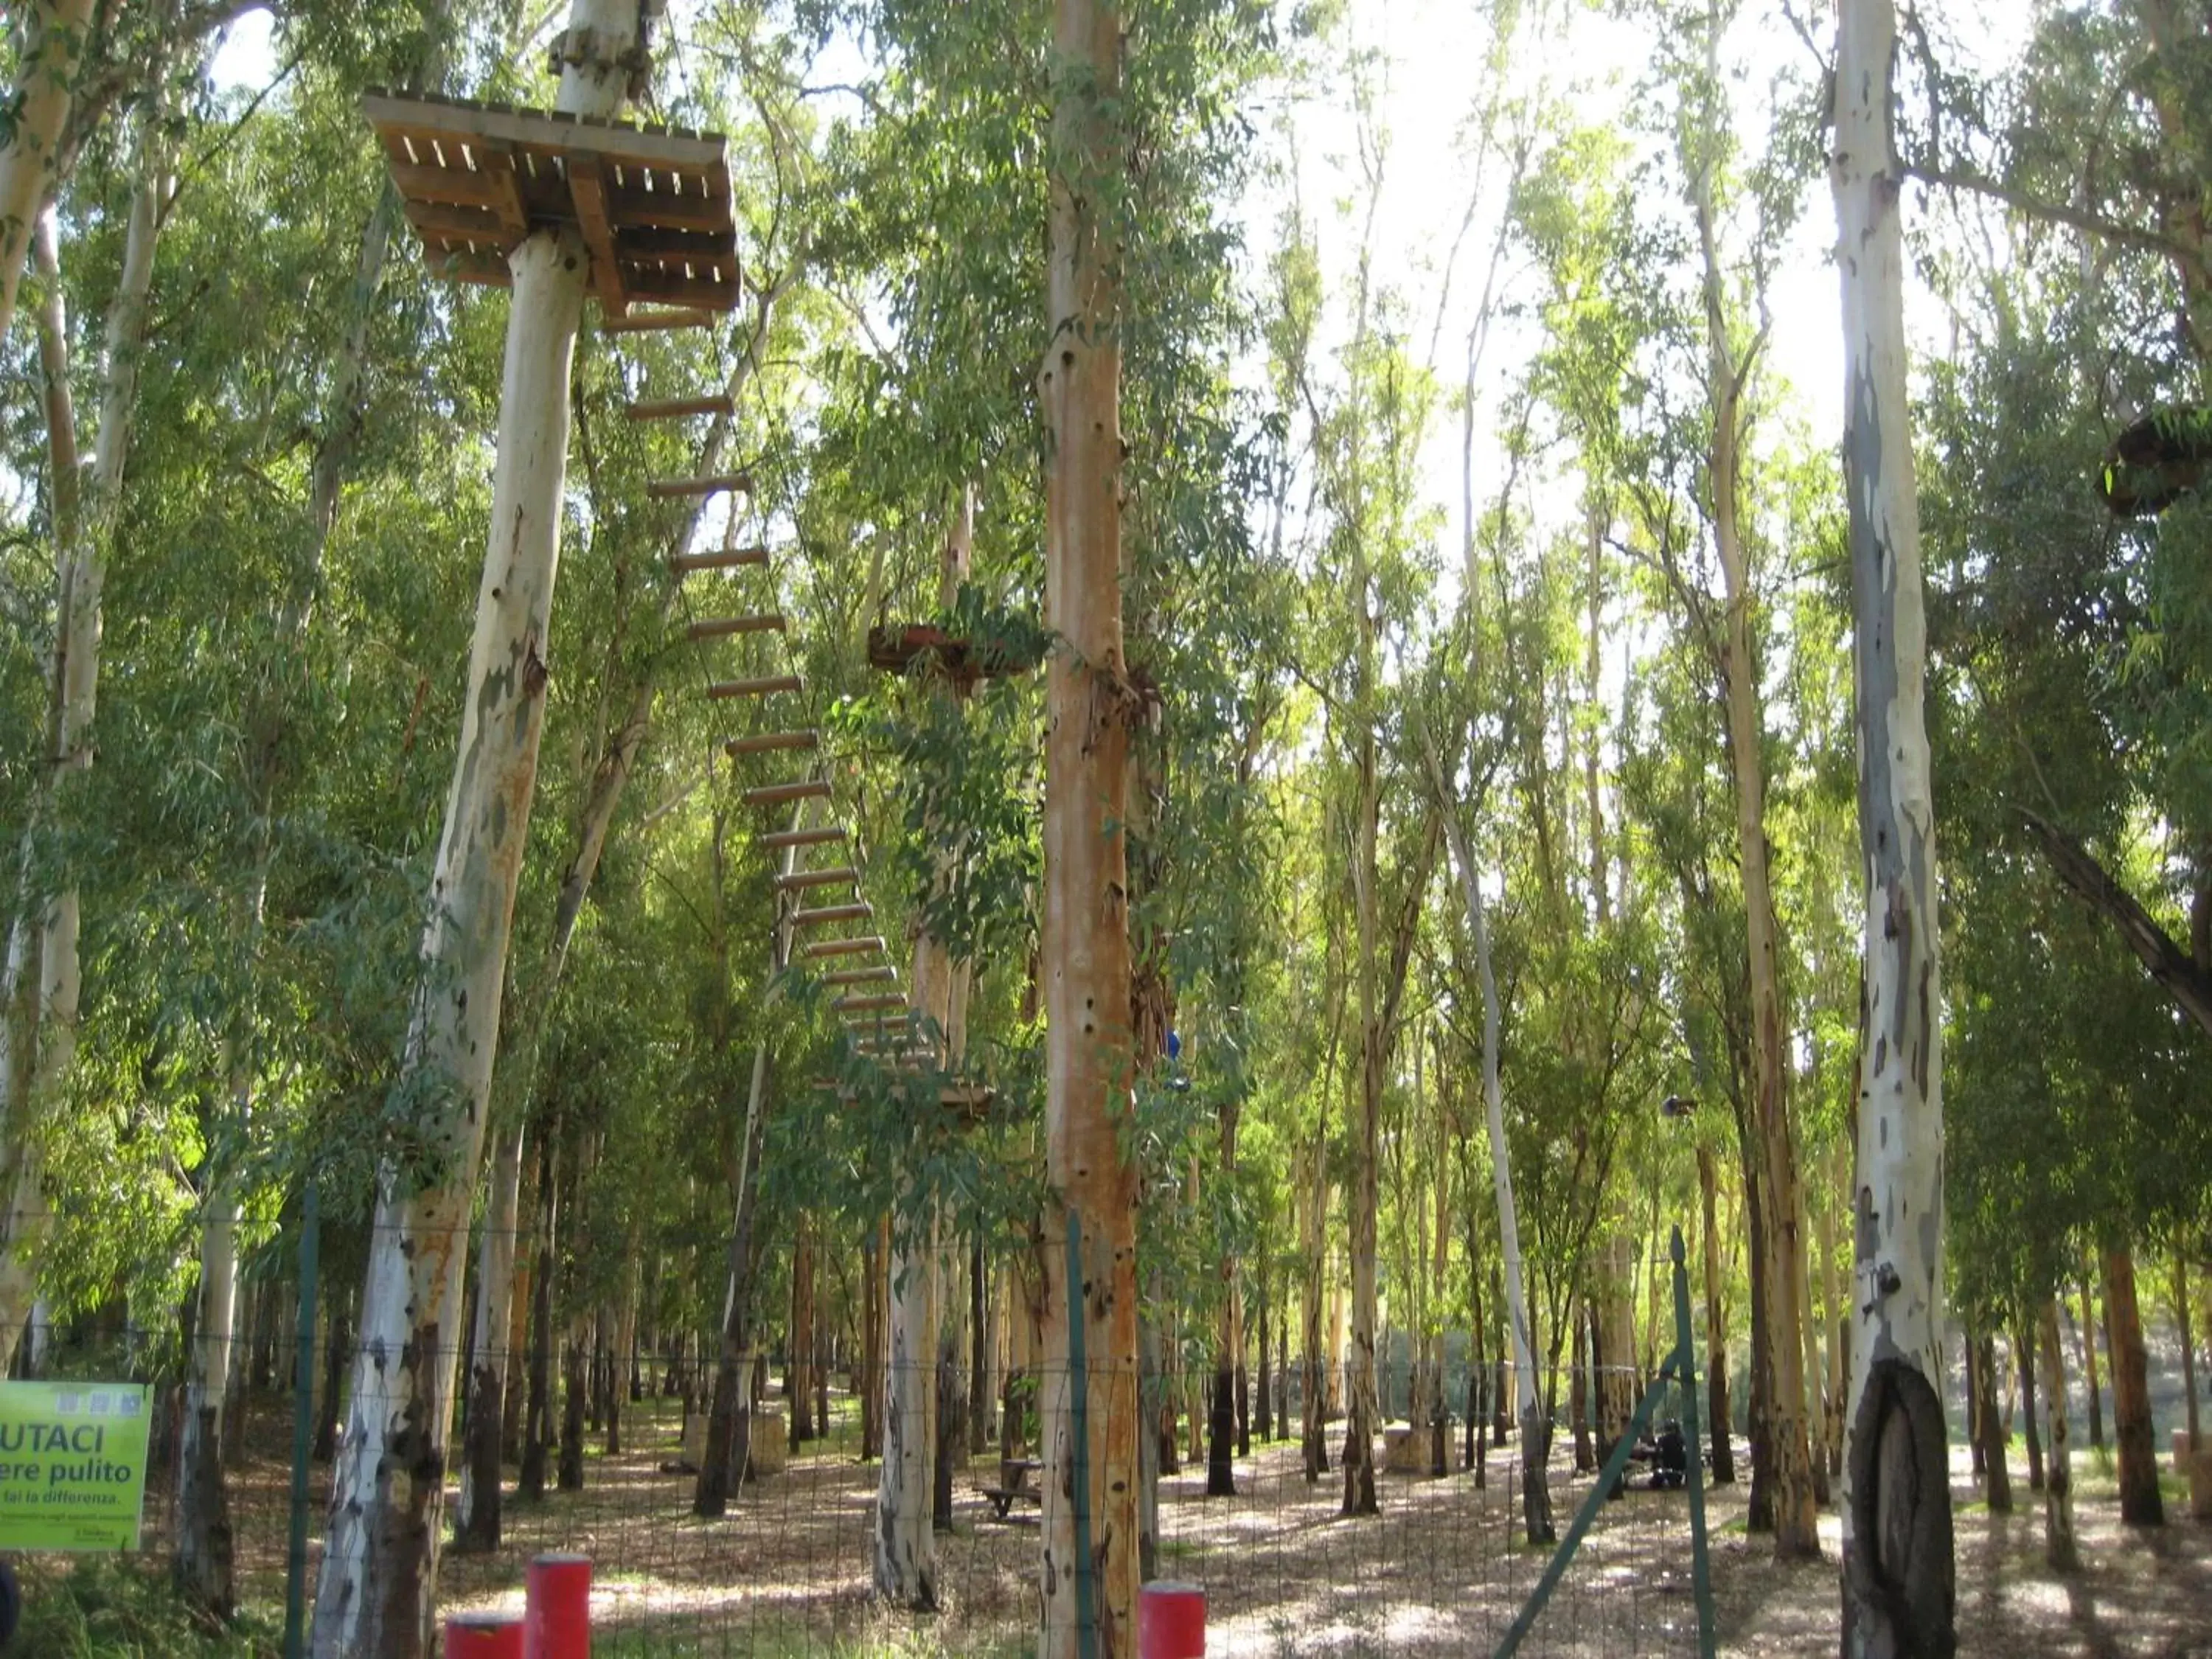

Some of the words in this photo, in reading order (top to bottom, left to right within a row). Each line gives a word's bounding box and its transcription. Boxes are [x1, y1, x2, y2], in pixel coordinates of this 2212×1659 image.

[1, 1423, 104, 1453] UTACI
[49, 1457, 131, 1486] pulito
[26, 1489, 38, 1503] la
